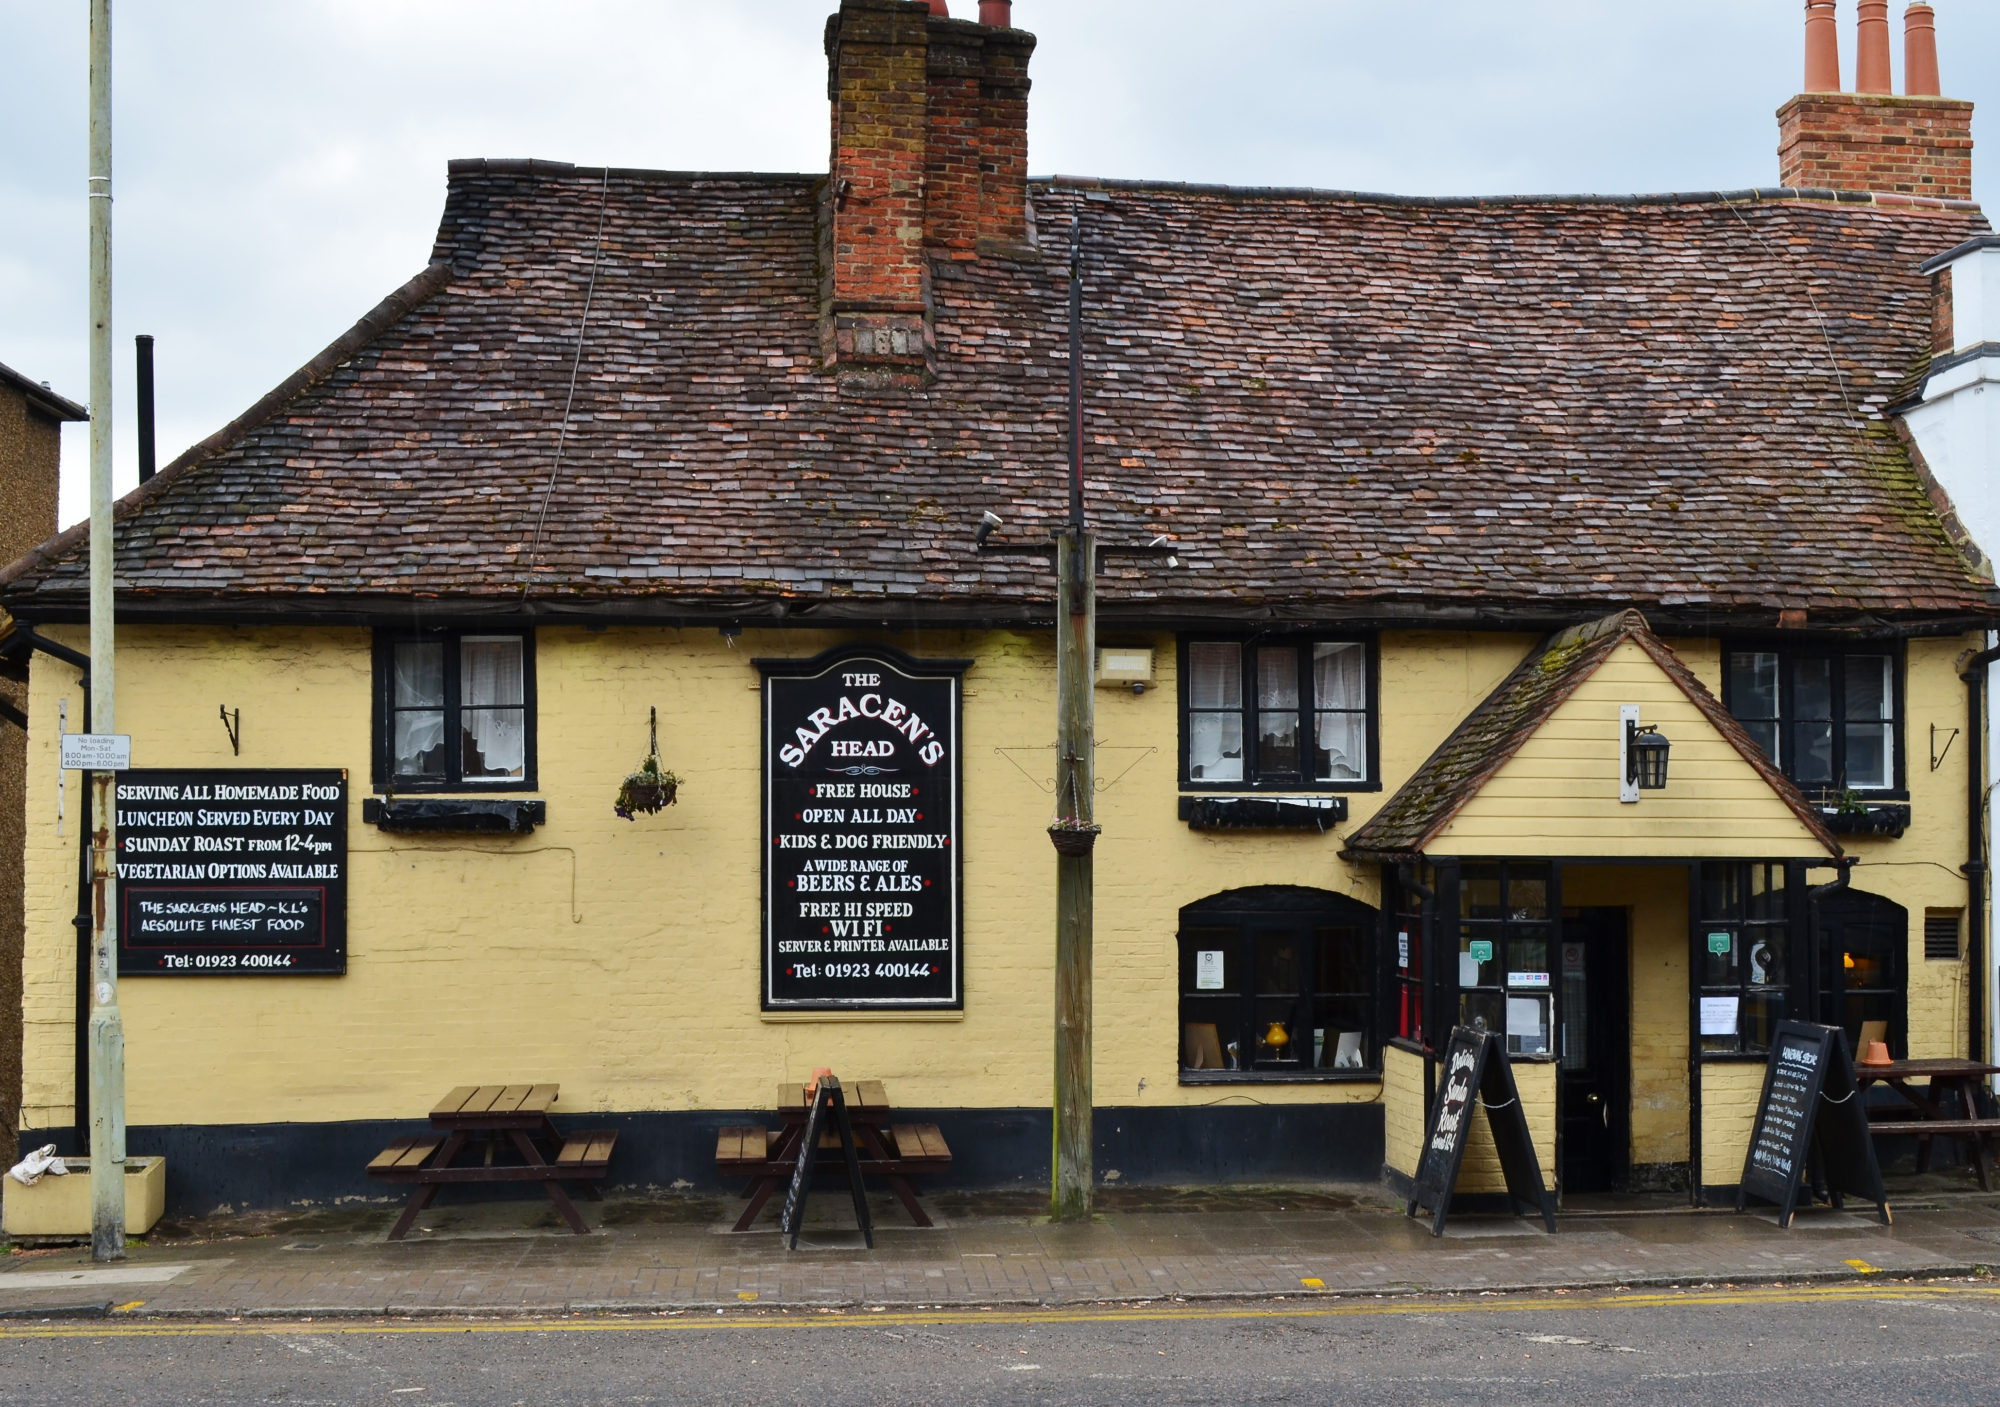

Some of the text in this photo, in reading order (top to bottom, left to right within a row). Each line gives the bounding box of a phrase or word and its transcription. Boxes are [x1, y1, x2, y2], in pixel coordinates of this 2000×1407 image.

[842, 674, 880, 686] THE
[780, 694, 944, 767] SARACEN'S
[89, 737, 115, 745] loading
[831, 741, 894, 756] HEAD
[117, 785, 340, 800] SERVING ALL HOMEMADE FOOD
[816, 784, 910, 798] FREE HOUSE
[117, 809, 334, 826] LUNCHEON SERVED EVERY DAY
[803, 809, 917, 823] OPEN ALL DAY
[126, 837, 190, 852] SUNDAY
[194, 836, 245, 851] ROAST
[248, 840, 282, 851] FROM
[780, 834, 945, 849] KIDS & DOG FRIENDLY
[116, 863, 338, 879] VEGETARIAN OPTIONS AVAILABLE
[803, 860, 908, 872] A WIDE RANGE OF
[797, 875, 922, 891] BEERS & ALES
[140, 902, 164, 914] THE
[166, 903, 226, 913] SARACENS
[231, 902, 265, 914] HEAD
[800, 902, 913, 917] FREE HI SPEED
[142, 918, 304, 932] ABSOLUTE FINEST FOOD
[779, 939, 948, 952] SERVER & PRINTER AVAILABLE
[164, 955, 291, 967] Tel: 01923 400144
[793, 963, 930, 977] Tel: 01923 400144
